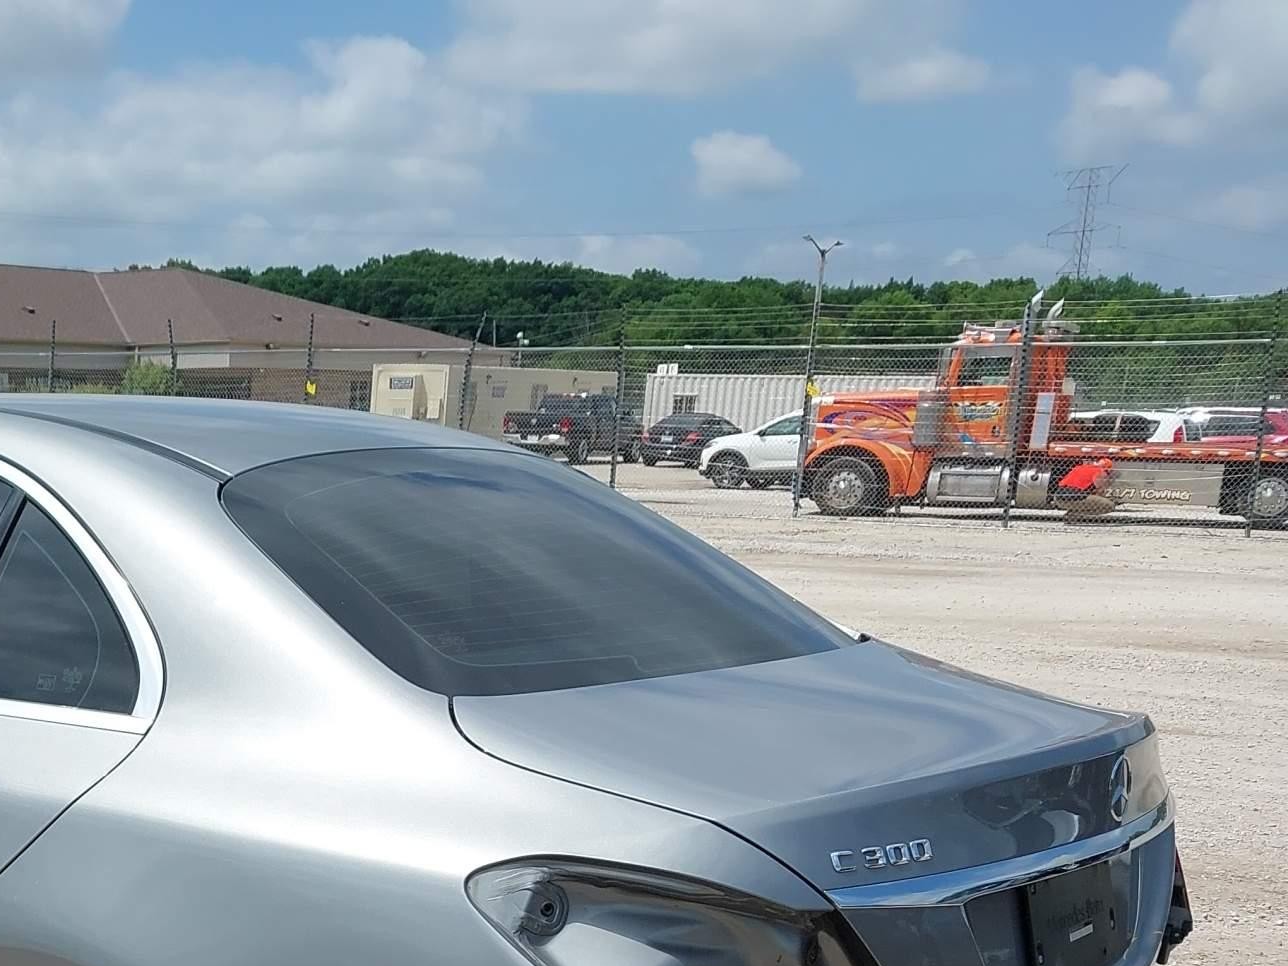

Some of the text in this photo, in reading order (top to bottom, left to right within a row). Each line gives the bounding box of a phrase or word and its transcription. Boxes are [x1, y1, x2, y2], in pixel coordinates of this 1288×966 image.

[1139, 489, 1192, 501] TOWING
[830, 838, 934, 873] C 300
